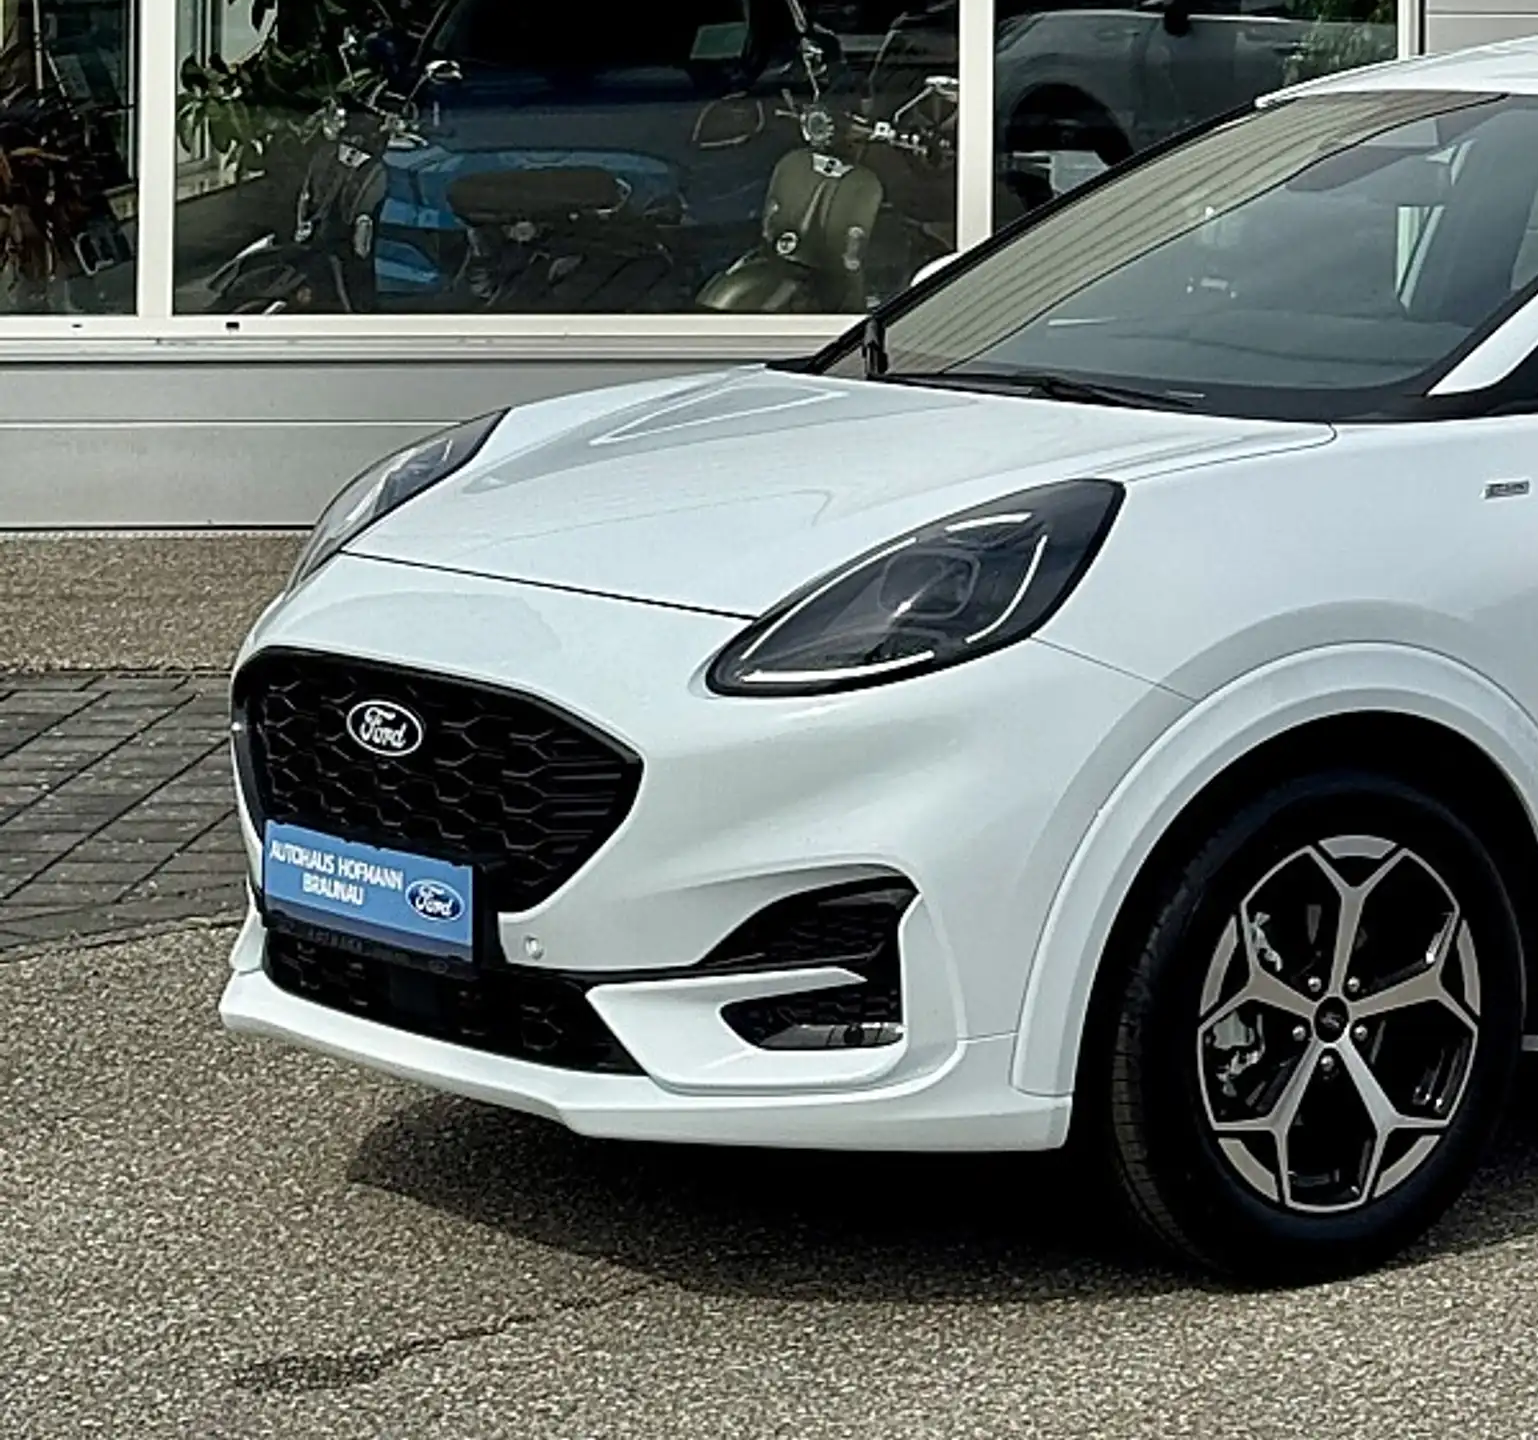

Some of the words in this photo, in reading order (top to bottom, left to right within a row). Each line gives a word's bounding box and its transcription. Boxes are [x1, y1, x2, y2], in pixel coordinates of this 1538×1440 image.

[360, 707, 407, 748] Ford
[269, 840, 334, 875] AUTOHAUS
[337, 856, 404, 890] HOFMANN
[302, 872, 365, 906] BRAUNAU
[415, 884, 453, 917] Ford
